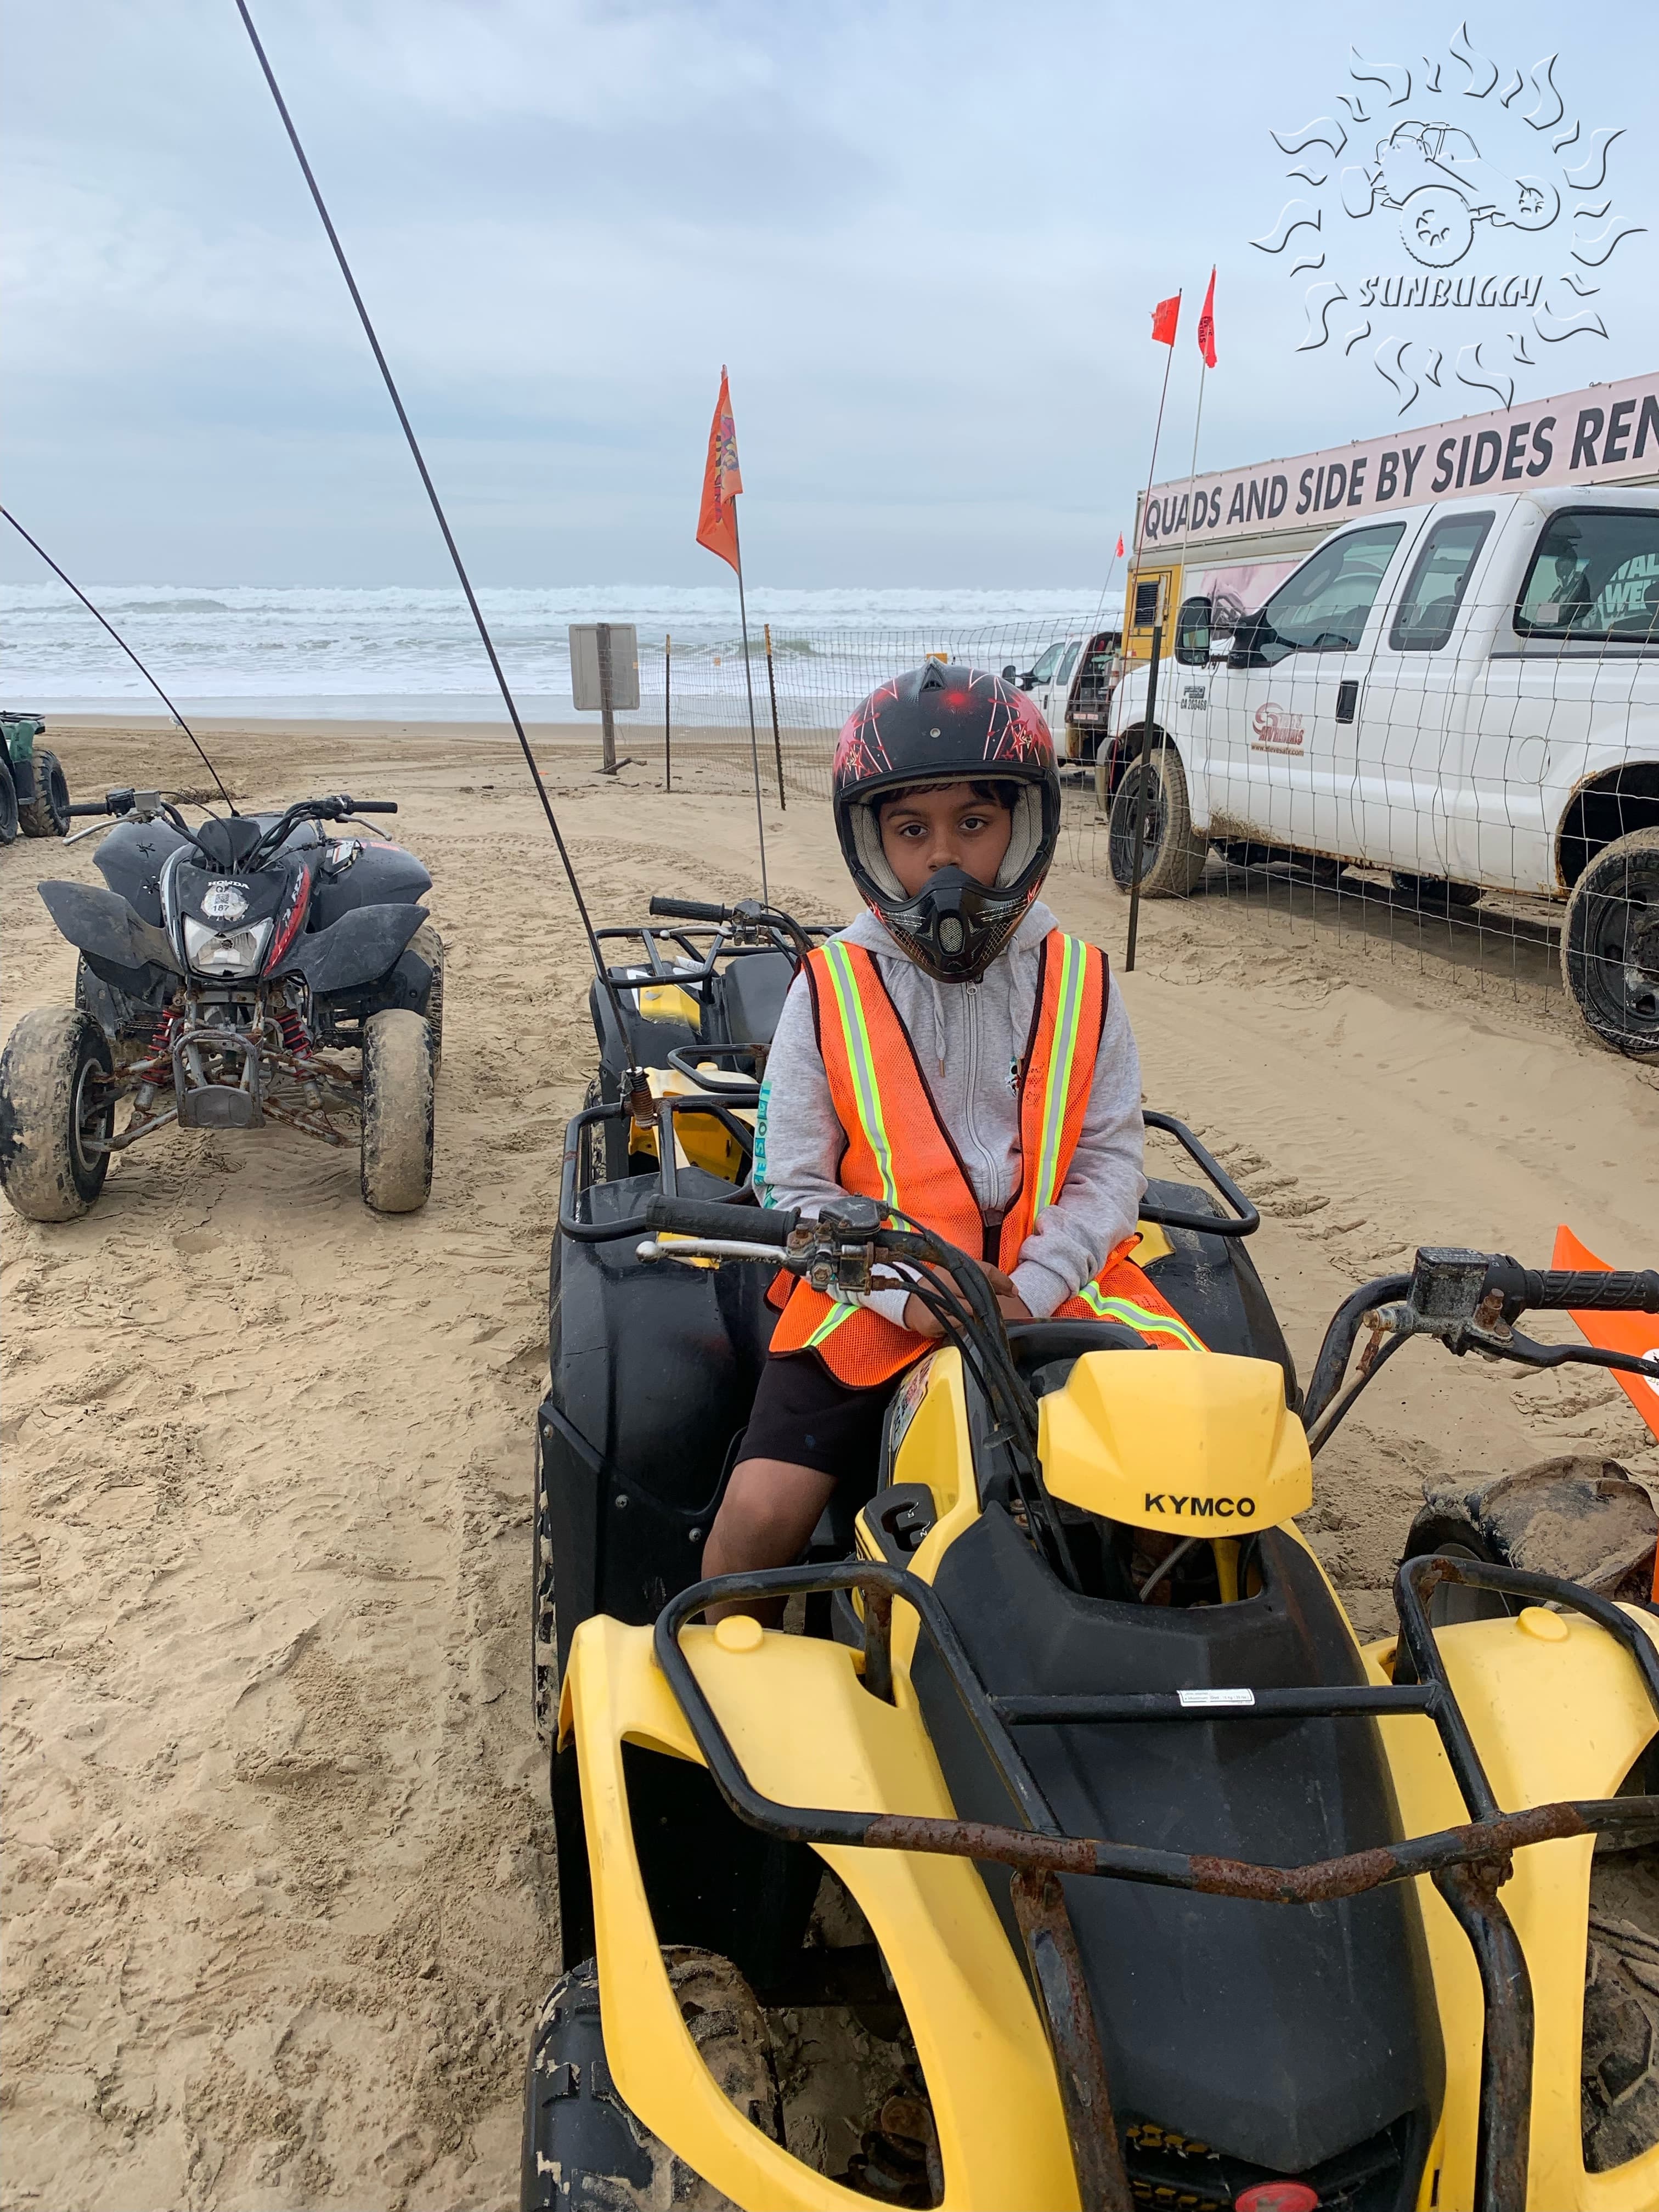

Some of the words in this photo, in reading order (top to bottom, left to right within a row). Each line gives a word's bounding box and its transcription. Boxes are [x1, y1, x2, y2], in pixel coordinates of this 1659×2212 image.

[1145, 486, 1222, 540] QUADS
[1226, 474, 1288, 525] AND
[1295, 457, 1367, 515] SIDE
[1375, 444, 1426, 502] BY
[1431, 416, 1557, 493] SIDES
[207, 881, 250, 890] HONDA
[1145, 1493, 1255, 1517] KYMCO
